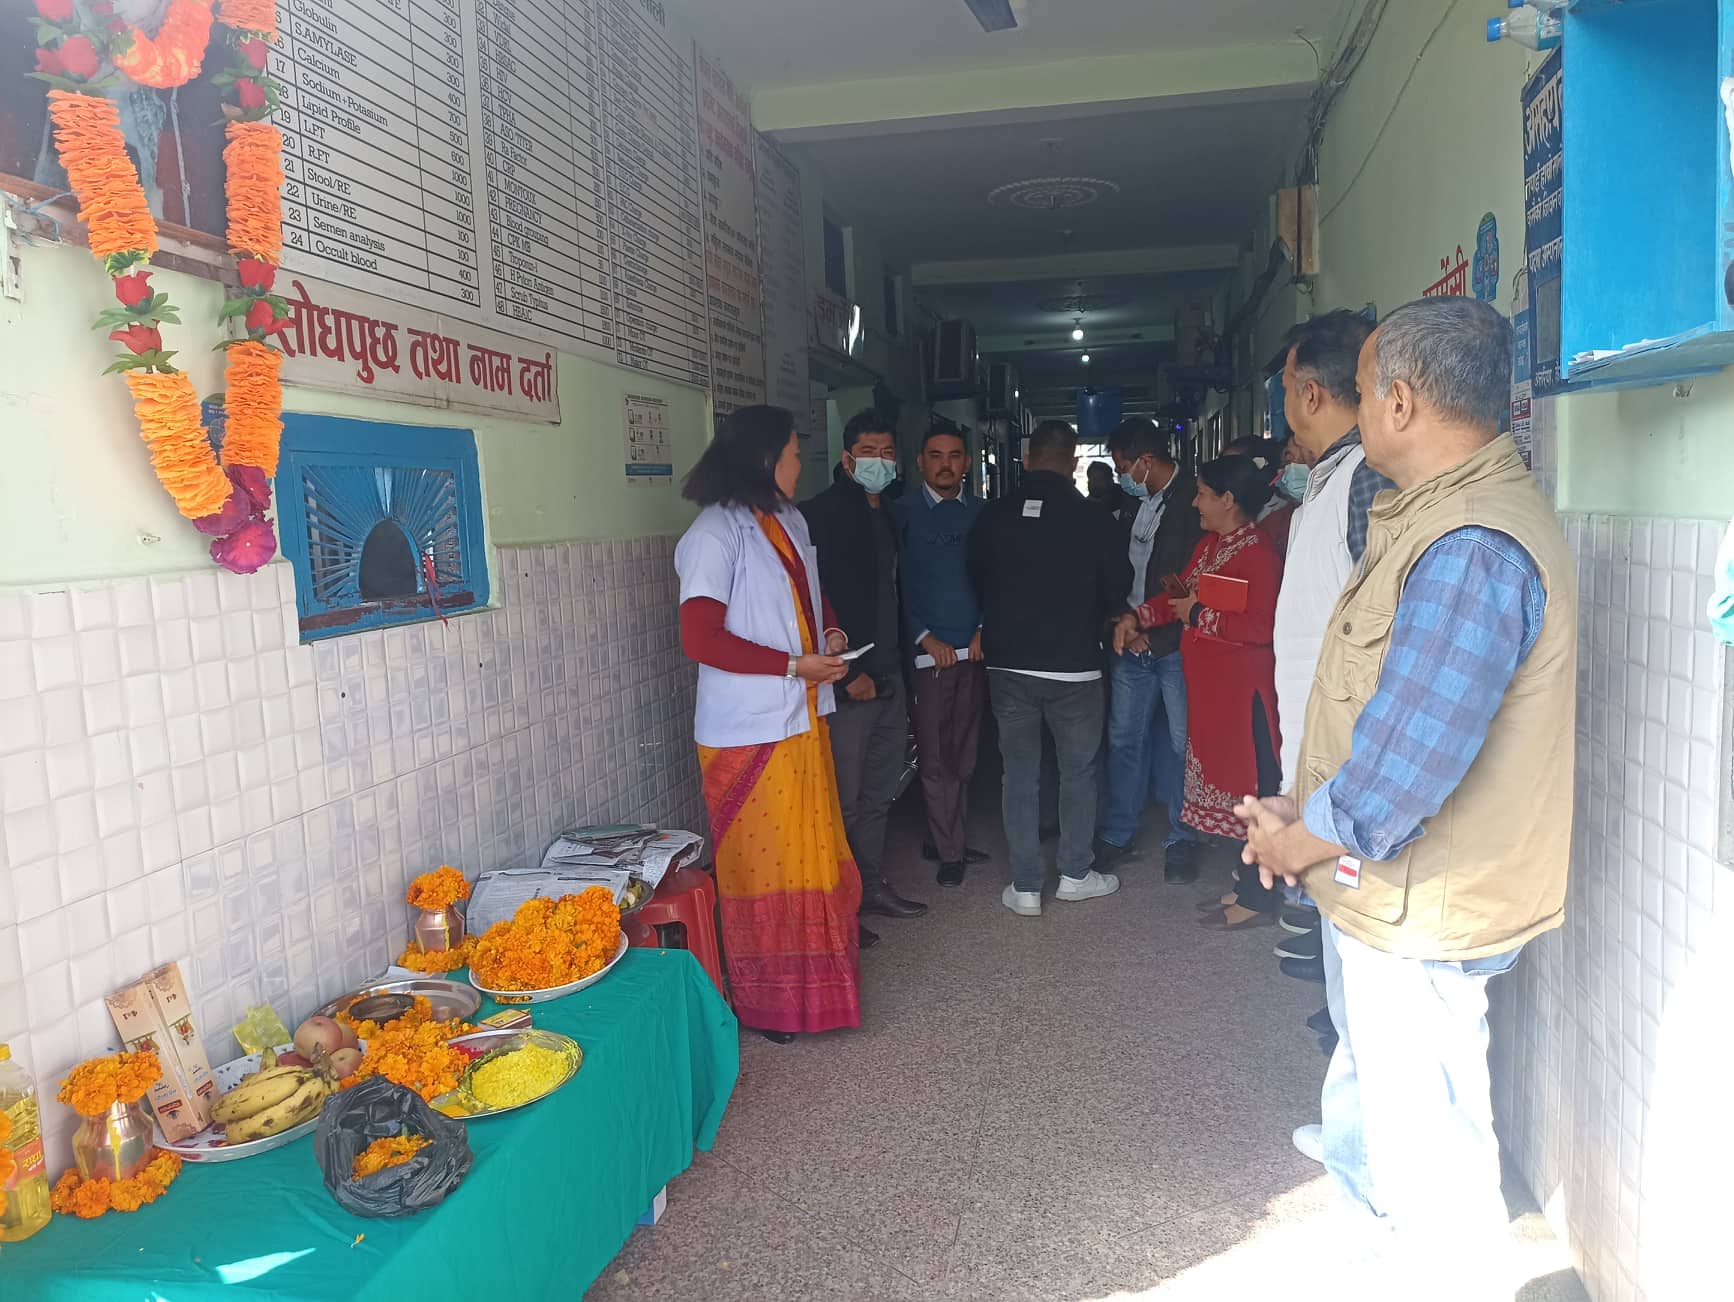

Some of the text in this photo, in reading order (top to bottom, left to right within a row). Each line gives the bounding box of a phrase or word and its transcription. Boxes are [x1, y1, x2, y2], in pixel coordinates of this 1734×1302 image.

[275, 58, 286, 74] 17
[295, 22, 358, 67] S.AMYLASE
[298, 47, 341, 80] Calcium
[449, 131, 463, 146] 500
[302, 95, 328, 119] Lipid
[331, 109, 361, 135] Profile
[282, 133, 296, 150] 20
[456, 210, 472, 226] 1000
[284, 158, 470, 244] 21 Stool/RE 100
[454, 190, 471, 207] 1000
[287, 183, 300, 198] 22
[457, 248, 470, 262] 100
[289, 207, 472, 282] 23 Semen analysis 400
[291, 231, 474, 301] 24 Occult blood 300
[407, 327, 461, 384] तथा
[467, 343, 512, 396] नाम
[517, 352, 553, 403] दर्ता
